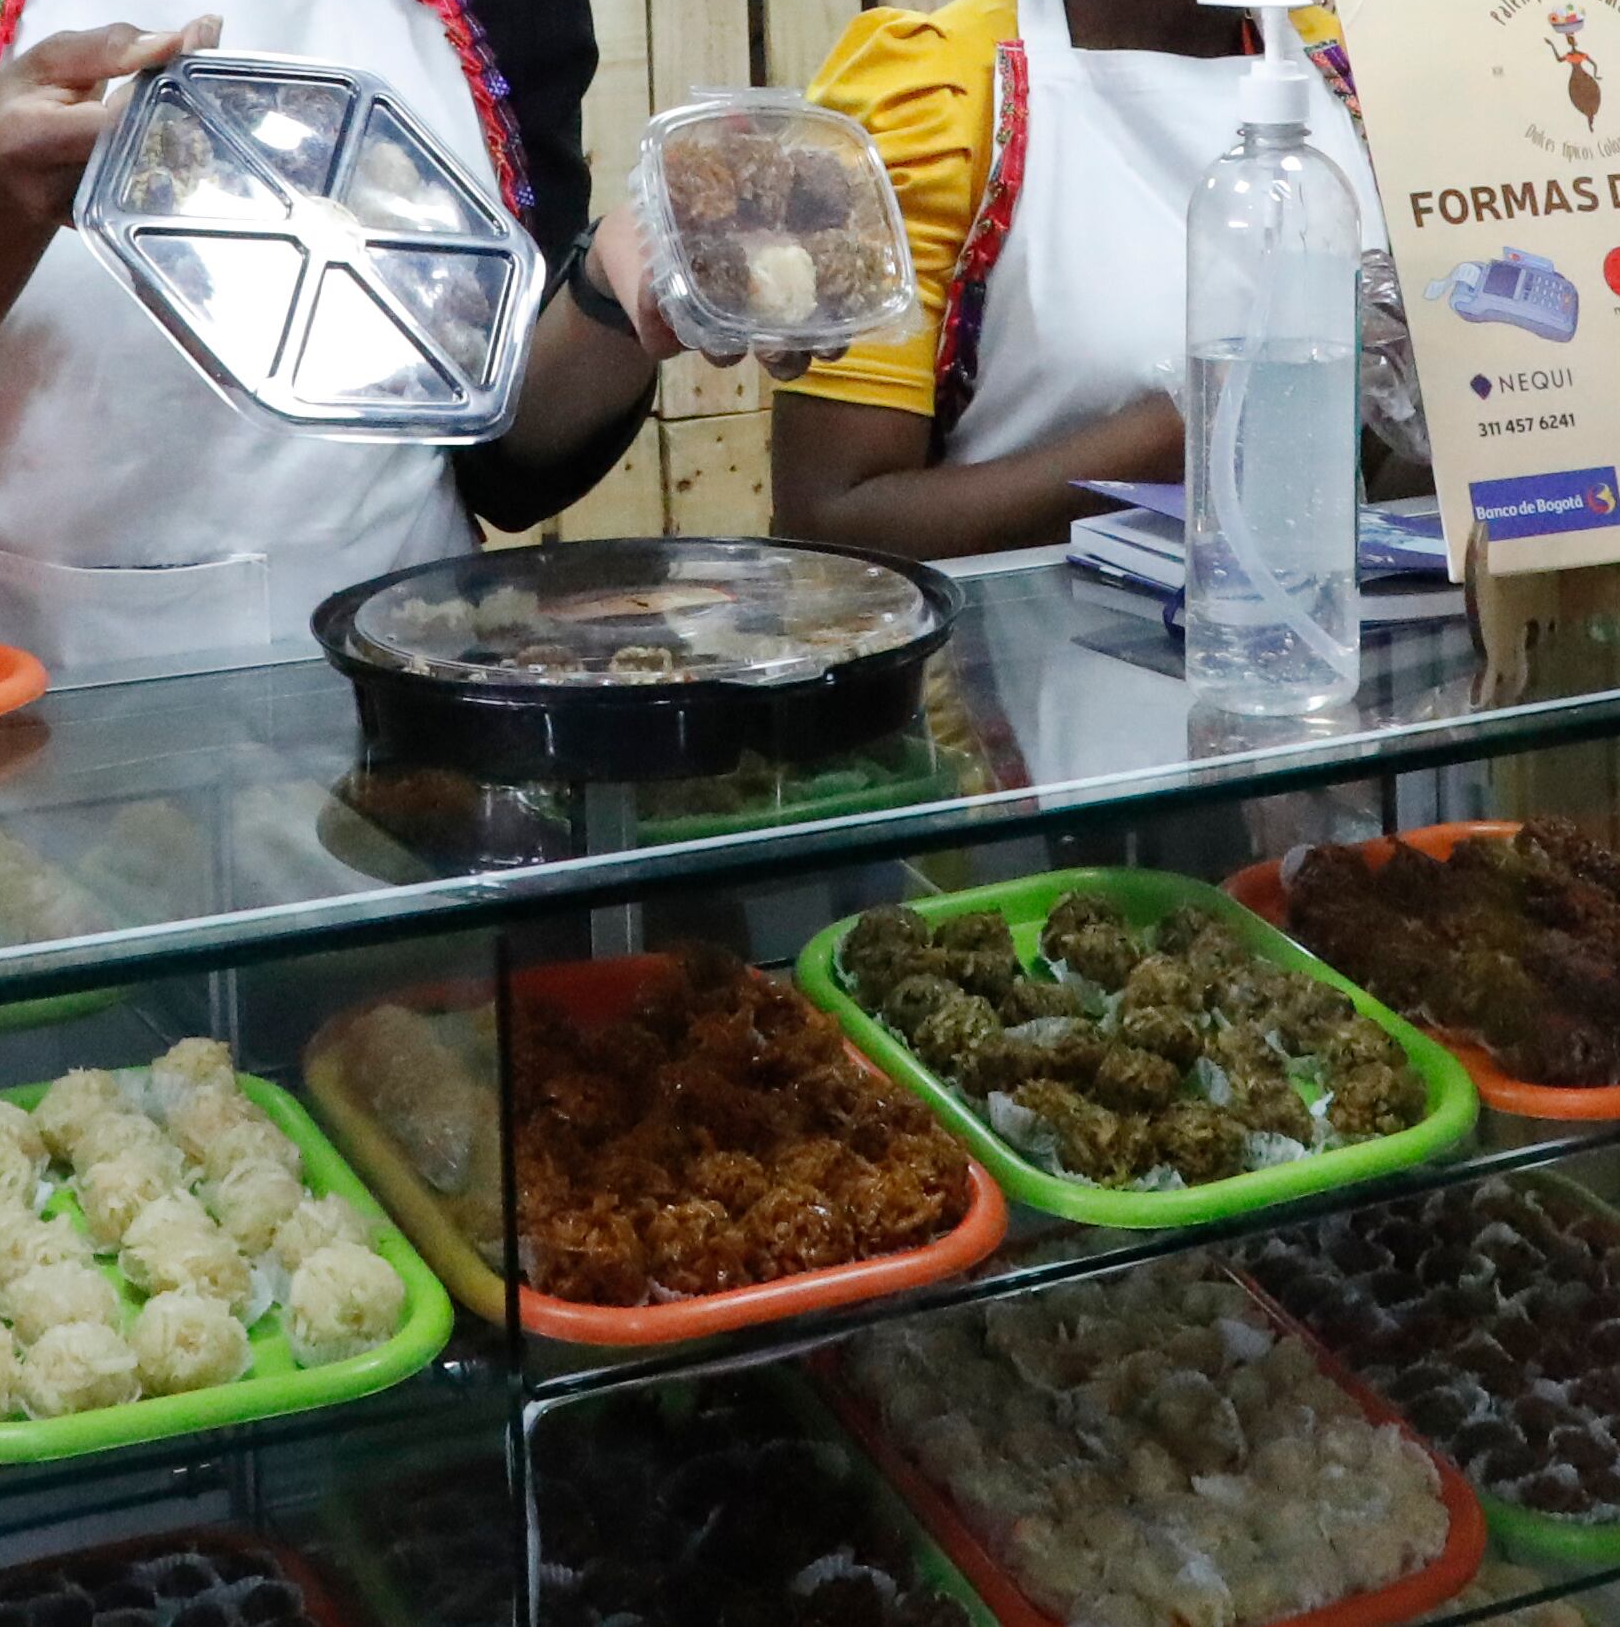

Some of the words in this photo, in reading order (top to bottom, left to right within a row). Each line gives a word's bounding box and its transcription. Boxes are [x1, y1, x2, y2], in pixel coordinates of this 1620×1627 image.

[1524, 123, 1555, 154] Dulces
[1410, 176, 1600, 228] FORMAS
[1498, 367, 1574, 394] NEQUI
[1478, 421, 1502, 437] 311
[1505, 417, 1534, 434] 457
[1539, 412, 1576, 431] 6241
[1475, 504, 1518, 521] Banco
[1519, 500, 1536, 515] de
[1536, 494, 1584, 517] Bogotá
